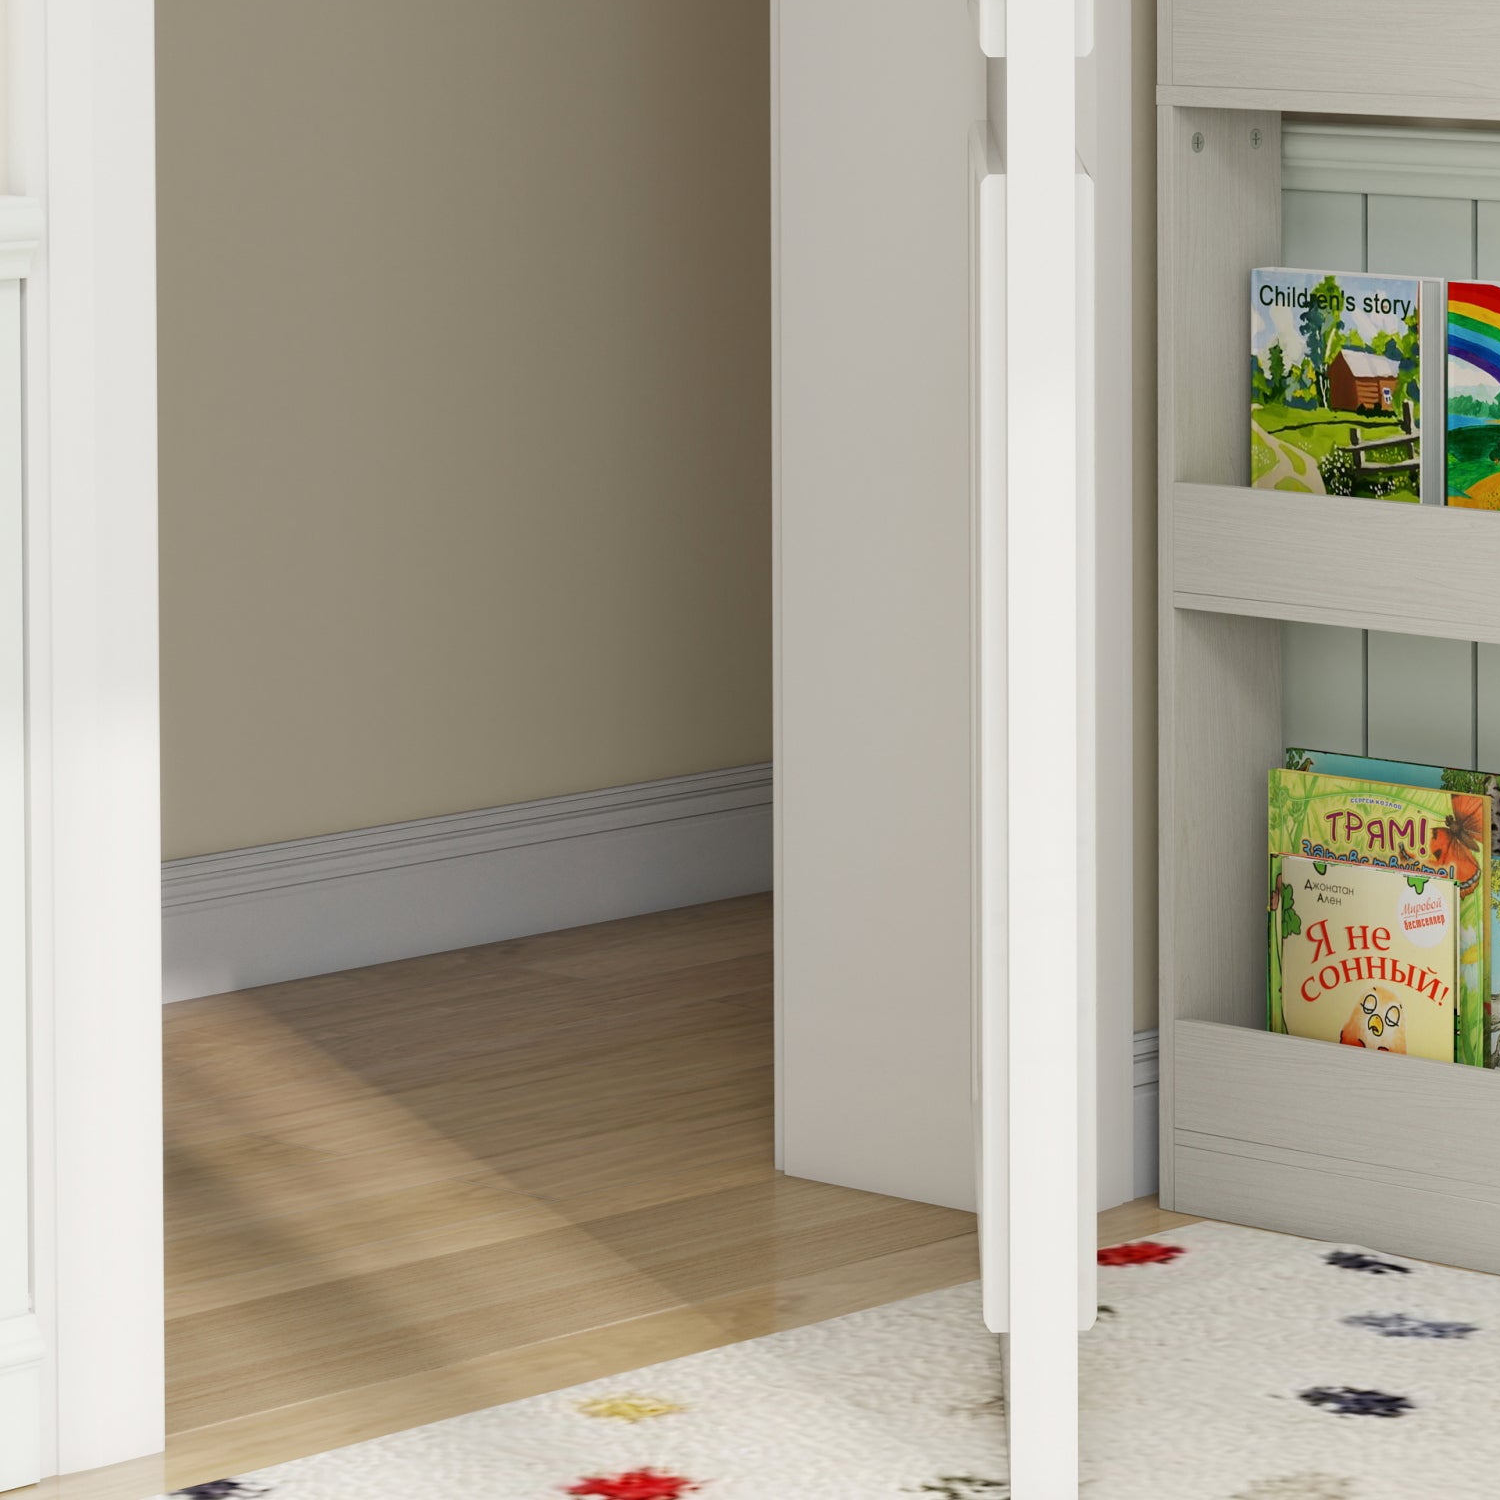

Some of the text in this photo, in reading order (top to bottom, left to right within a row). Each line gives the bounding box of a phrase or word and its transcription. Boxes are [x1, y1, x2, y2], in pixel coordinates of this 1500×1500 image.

[1259, 285, 1411, 321] Children's story
[1325, 810, 1428, 856] ТРЯМ!
[1304, 879, 1355, 896] Джонатан
[1317, 893, 1342, 906] Ален
[1305, 919, 1391, 964] Я не
[1300, 956, 1450, 1007] сонный!
